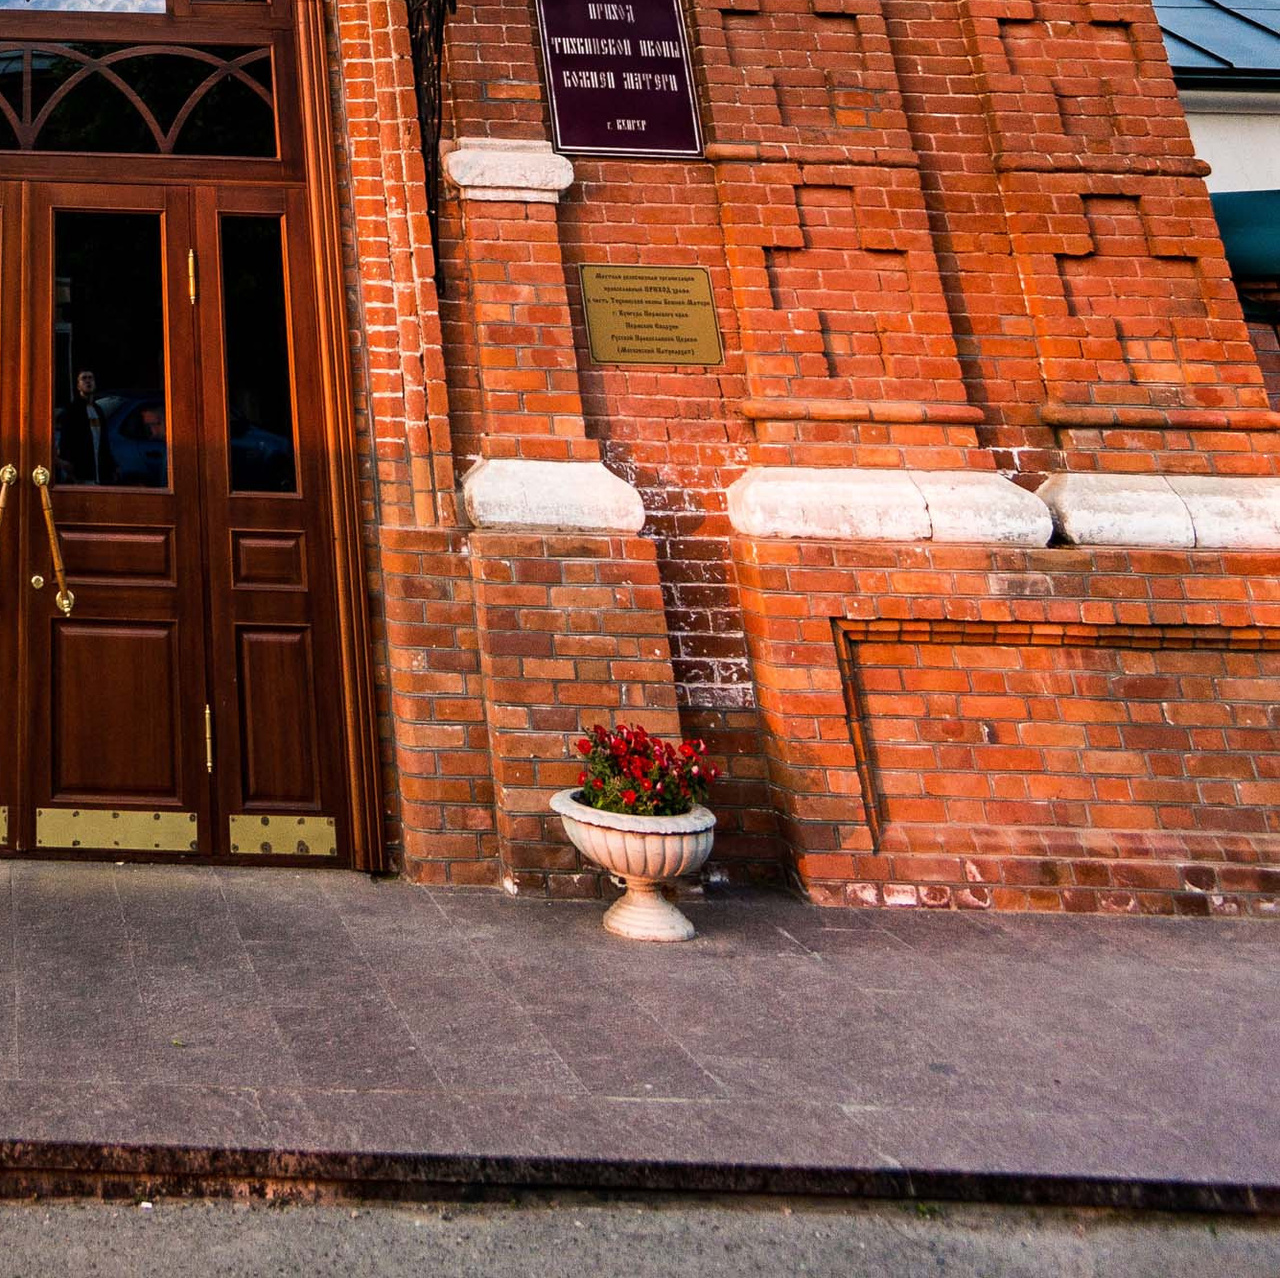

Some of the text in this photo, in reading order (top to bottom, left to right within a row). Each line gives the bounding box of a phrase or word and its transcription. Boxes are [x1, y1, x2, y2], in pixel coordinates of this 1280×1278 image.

[588, 3, 635, 23] ПРИХОД
[551, 37, 680, 58] ТИХВИНСКОЙ ИКОНЫ
[562, 70, 678, 92] БОЖИЕЙ МАТЕРИ
